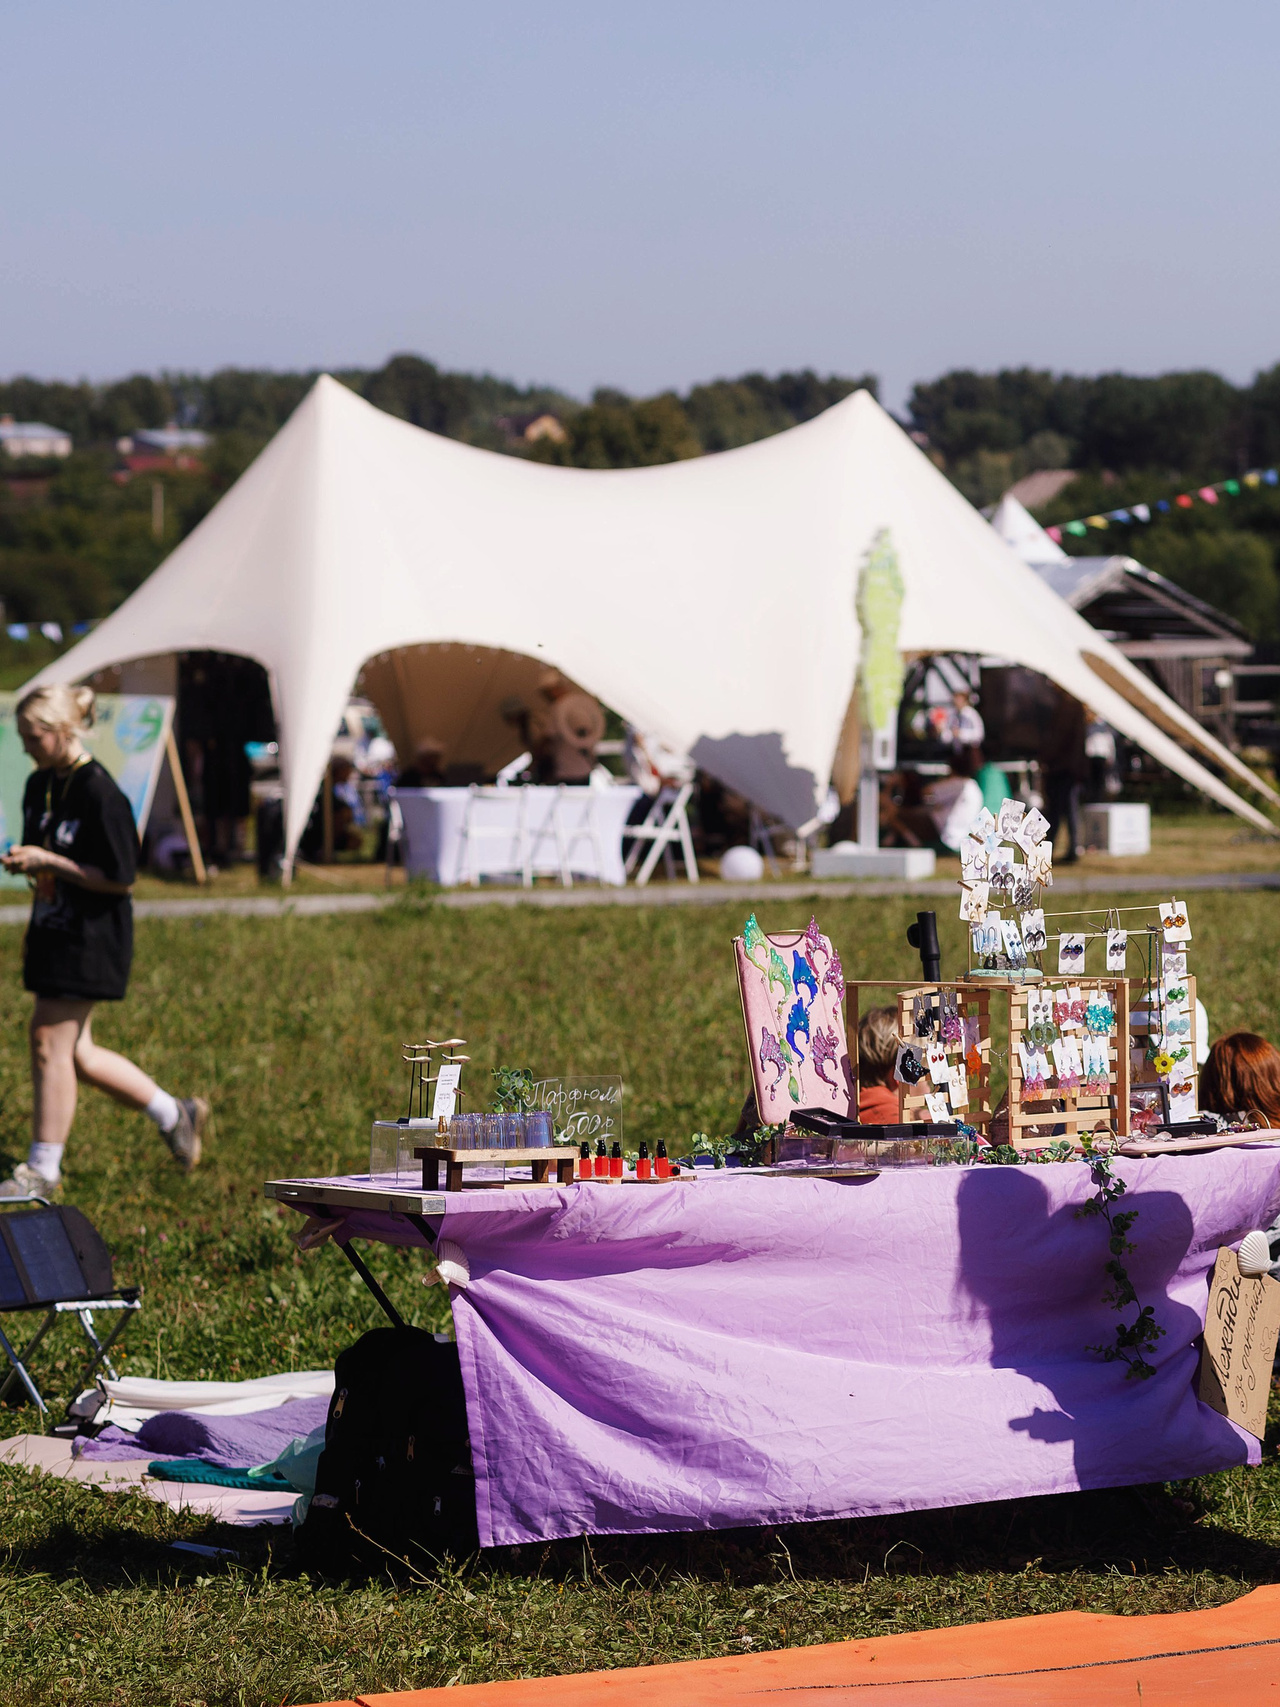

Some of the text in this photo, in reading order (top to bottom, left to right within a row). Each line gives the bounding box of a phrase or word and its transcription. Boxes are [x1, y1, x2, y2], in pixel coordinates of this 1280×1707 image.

[523, 1078, 618, 1121] Парфюм
[1211, 1276, 1242, 1404] Мехенди
[1234, 1374, 1248, 1415] за
